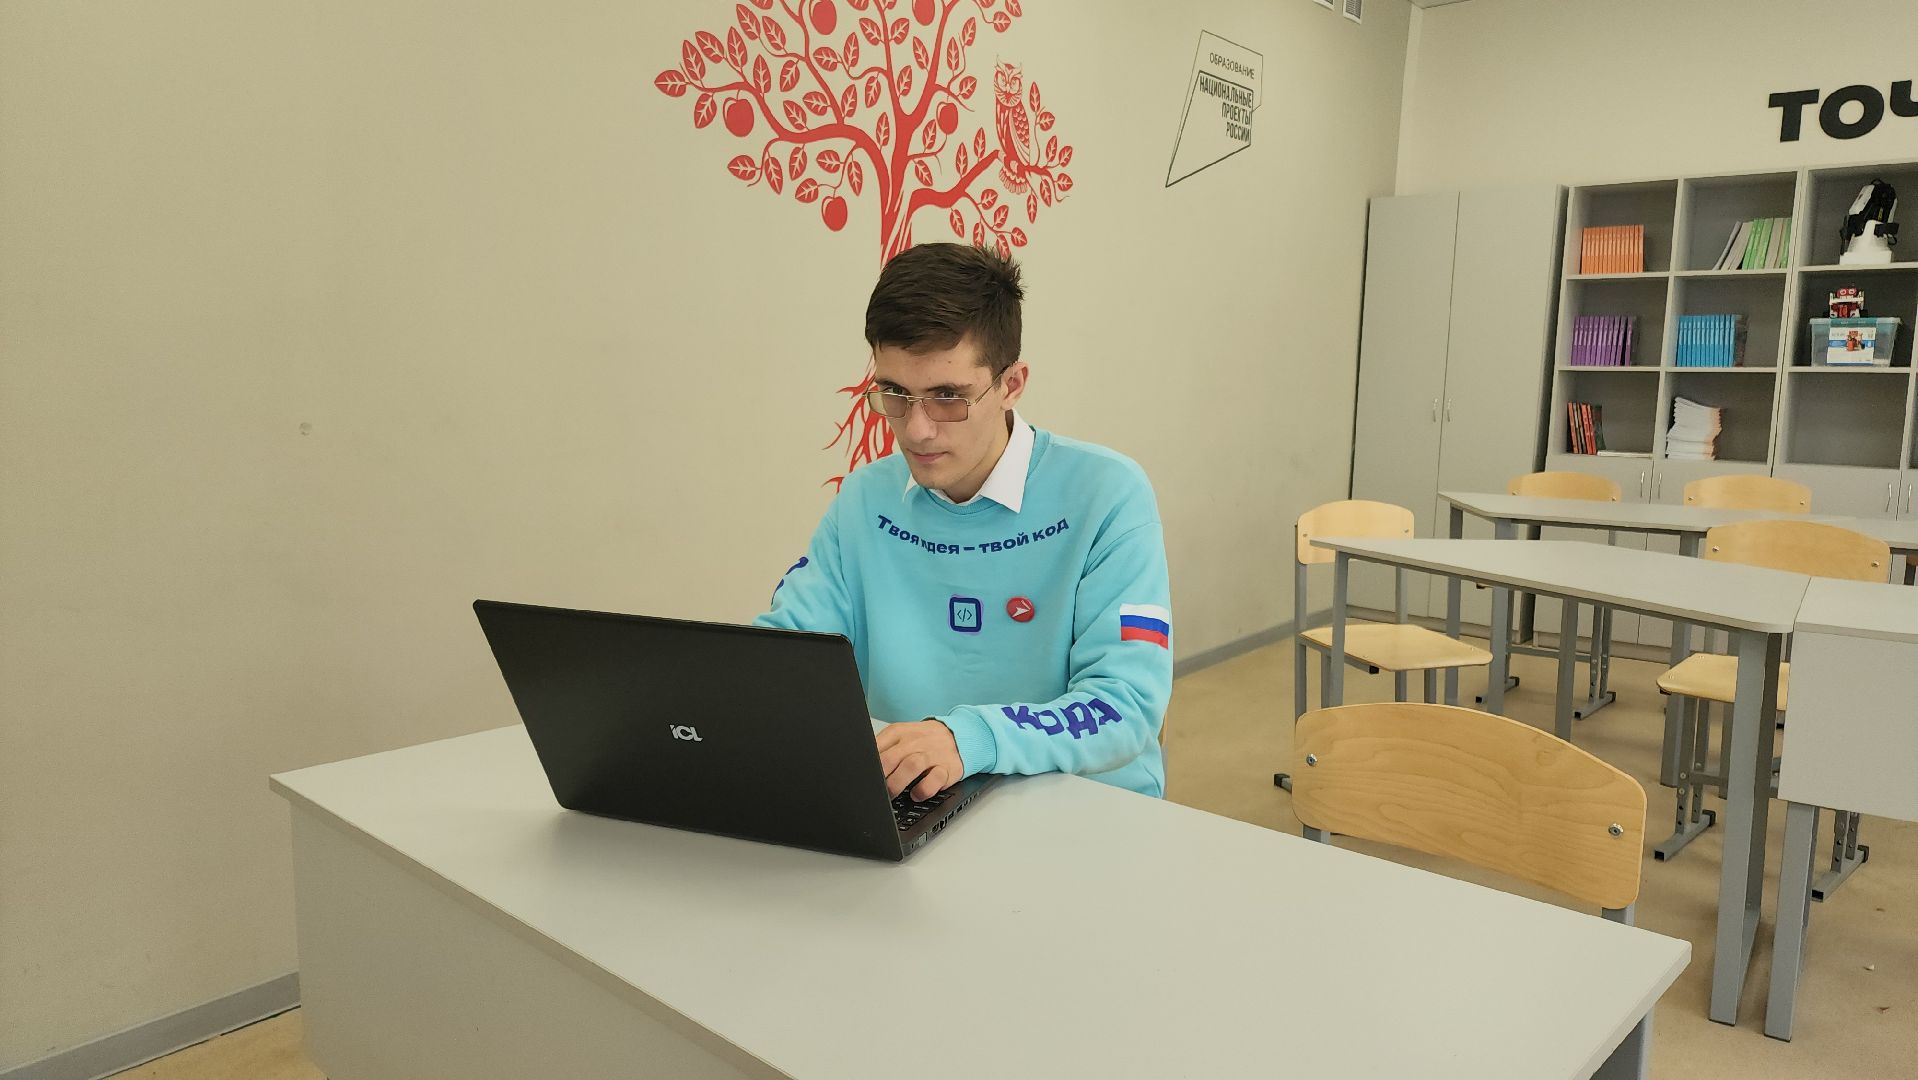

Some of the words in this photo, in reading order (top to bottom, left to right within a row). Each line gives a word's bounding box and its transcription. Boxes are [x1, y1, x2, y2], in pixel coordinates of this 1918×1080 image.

[1209, 52, 1255, 80] ОБРАЗОВАНИЕ
[1199, 75, 1252, 109] НАЦИОНАЛЬНЫЕ
[1221, 101, 1251, 125] ПРОЕКТЫ
[1225, 121, 1250, 142] РОССИИ
